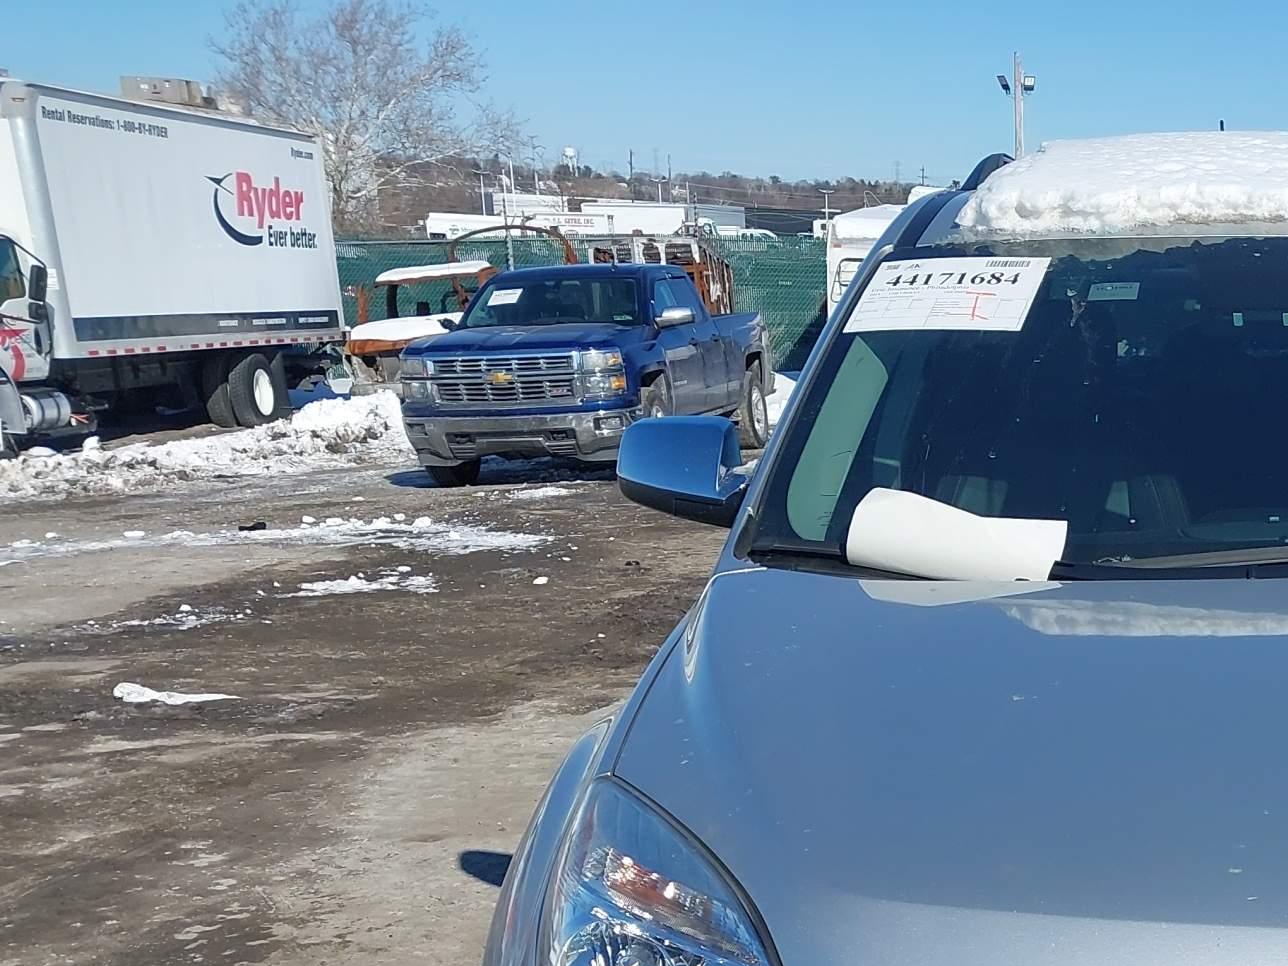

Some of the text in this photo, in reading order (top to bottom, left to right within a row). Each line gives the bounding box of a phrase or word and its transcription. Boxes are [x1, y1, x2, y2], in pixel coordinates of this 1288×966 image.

[41, 105, 66, 122] Rental
[67, 110, 115, 130] Reservations:
[235, 171, 304, 229] Ryder
[267, 224, 318, 249] Ever better.
[885, 271, 1022, 287] 44171684
